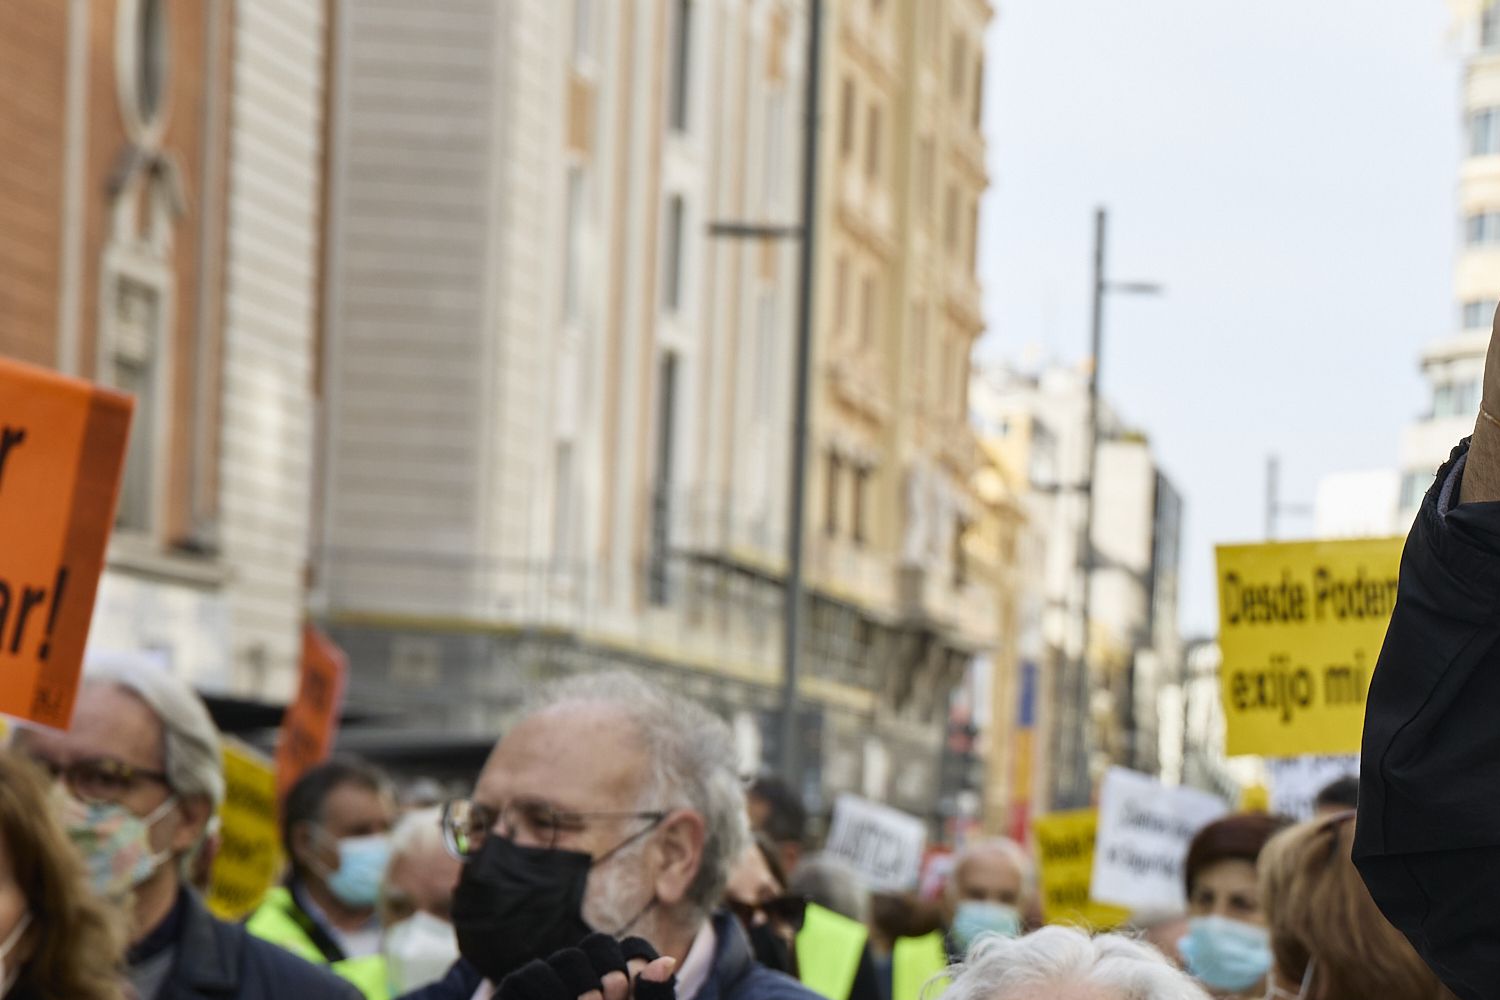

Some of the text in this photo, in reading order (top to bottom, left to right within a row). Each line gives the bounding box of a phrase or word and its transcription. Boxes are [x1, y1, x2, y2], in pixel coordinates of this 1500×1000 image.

[1224, 569, 1306, 626] Desde
[1230, 649, 1367, 725] exijo mi
